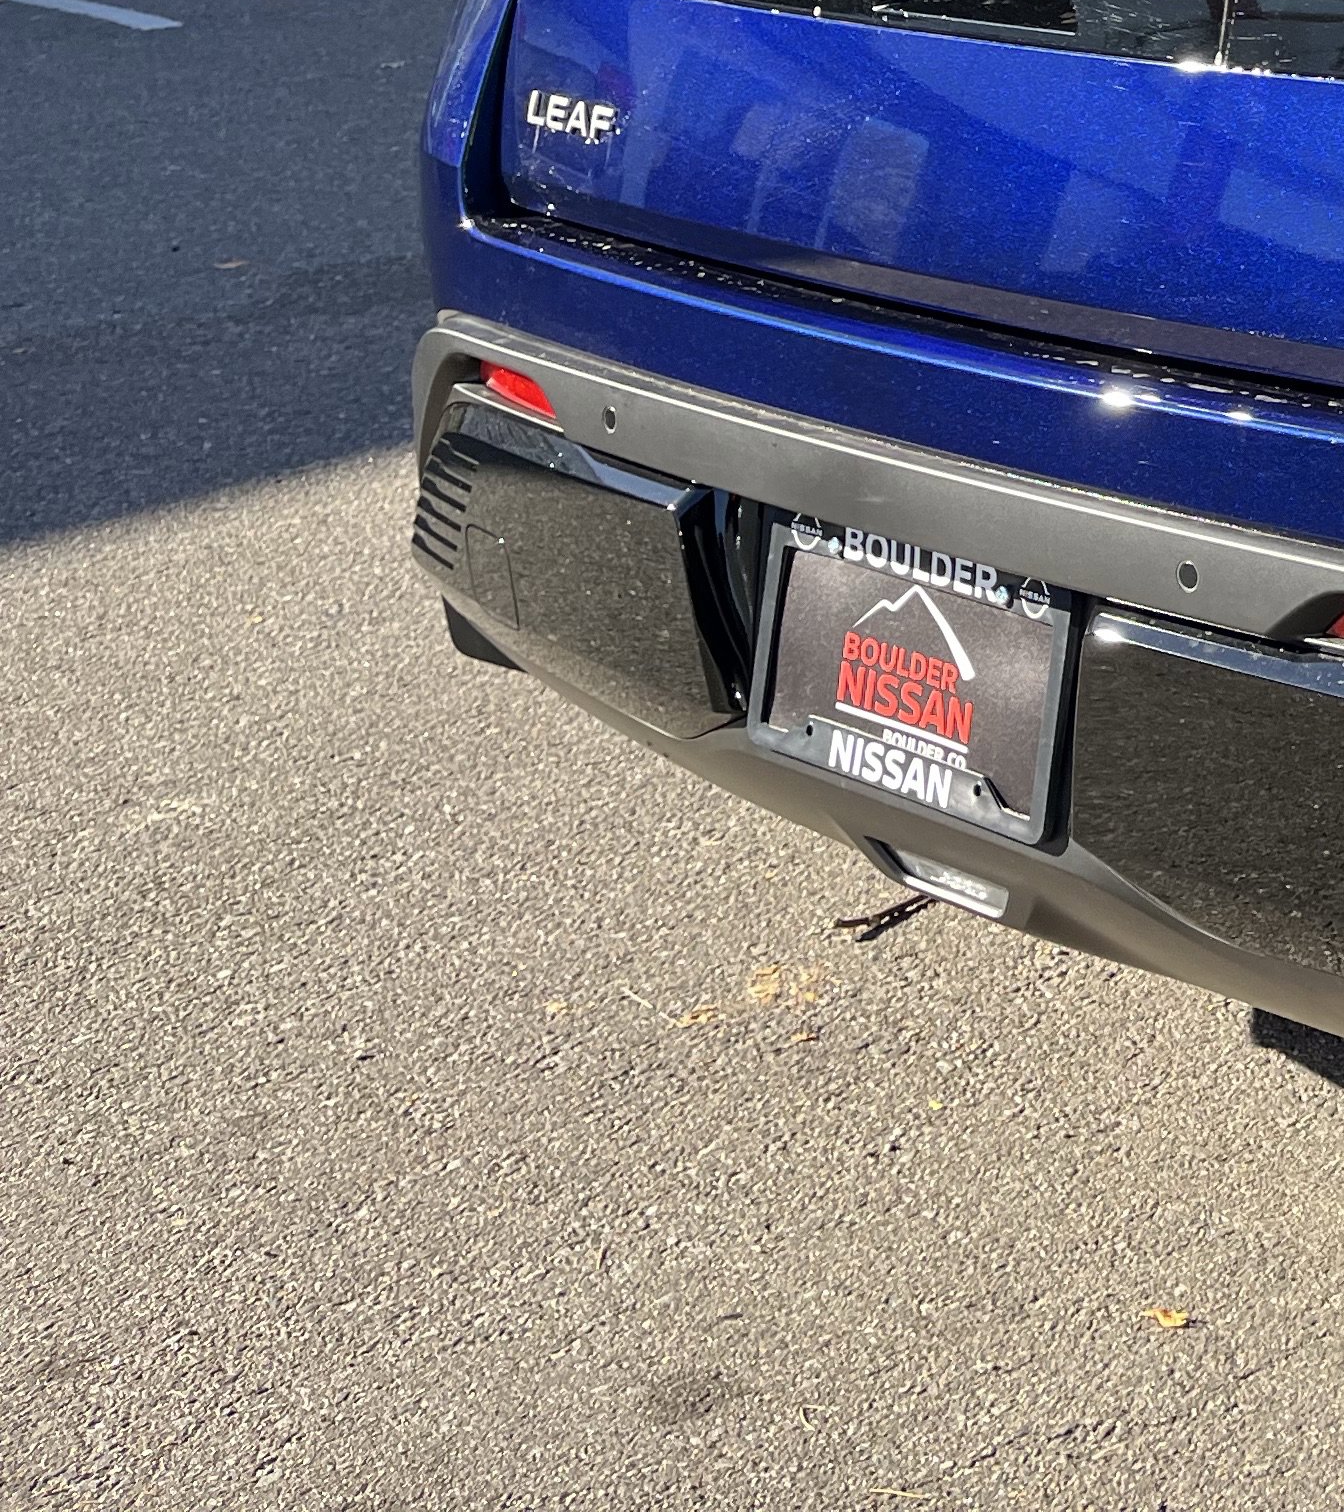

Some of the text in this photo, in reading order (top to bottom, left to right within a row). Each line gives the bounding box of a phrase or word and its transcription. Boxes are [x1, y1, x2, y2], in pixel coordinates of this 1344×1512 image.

[526, 89, 615, 139] LEAF
[790, 521, 823, 537] NISSAN
[842, 526, 998, 604] BOULDER
[1019, 588, 1050, 605] NISSAN
[842, 630, 959, 694] BOULDER
[836, 660, 973, 745] NISSAN
[827, 729, 953, 809] NISSAN
